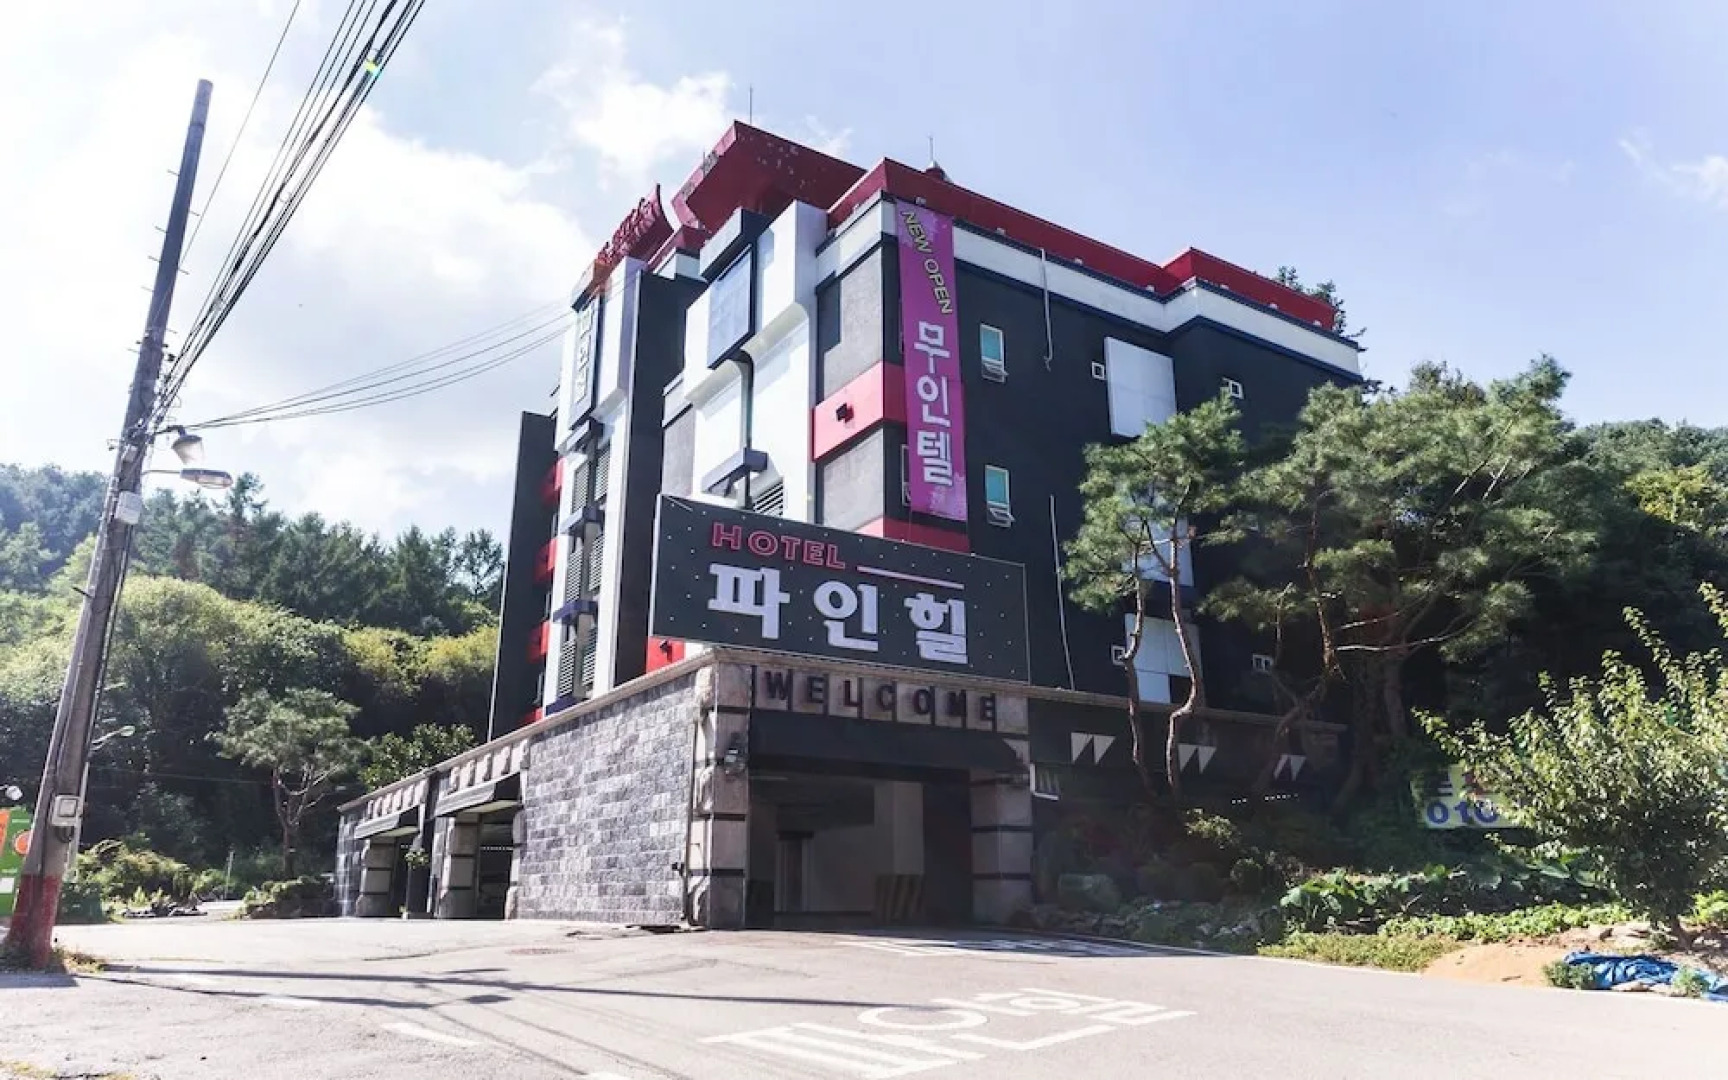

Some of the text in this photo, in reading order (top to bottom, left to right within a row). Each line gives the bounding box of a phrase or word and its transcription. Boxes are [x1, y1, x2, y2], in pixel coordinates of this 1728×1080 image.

[901, 211, 953, 315] NEW OPEN
[913, 320, 953, 487] 무인텔
[711, 521, 847, 570] HOTEL
[707, 563, 969, 665] 파인힐
[764, 670, 998, 722] WELCOME
